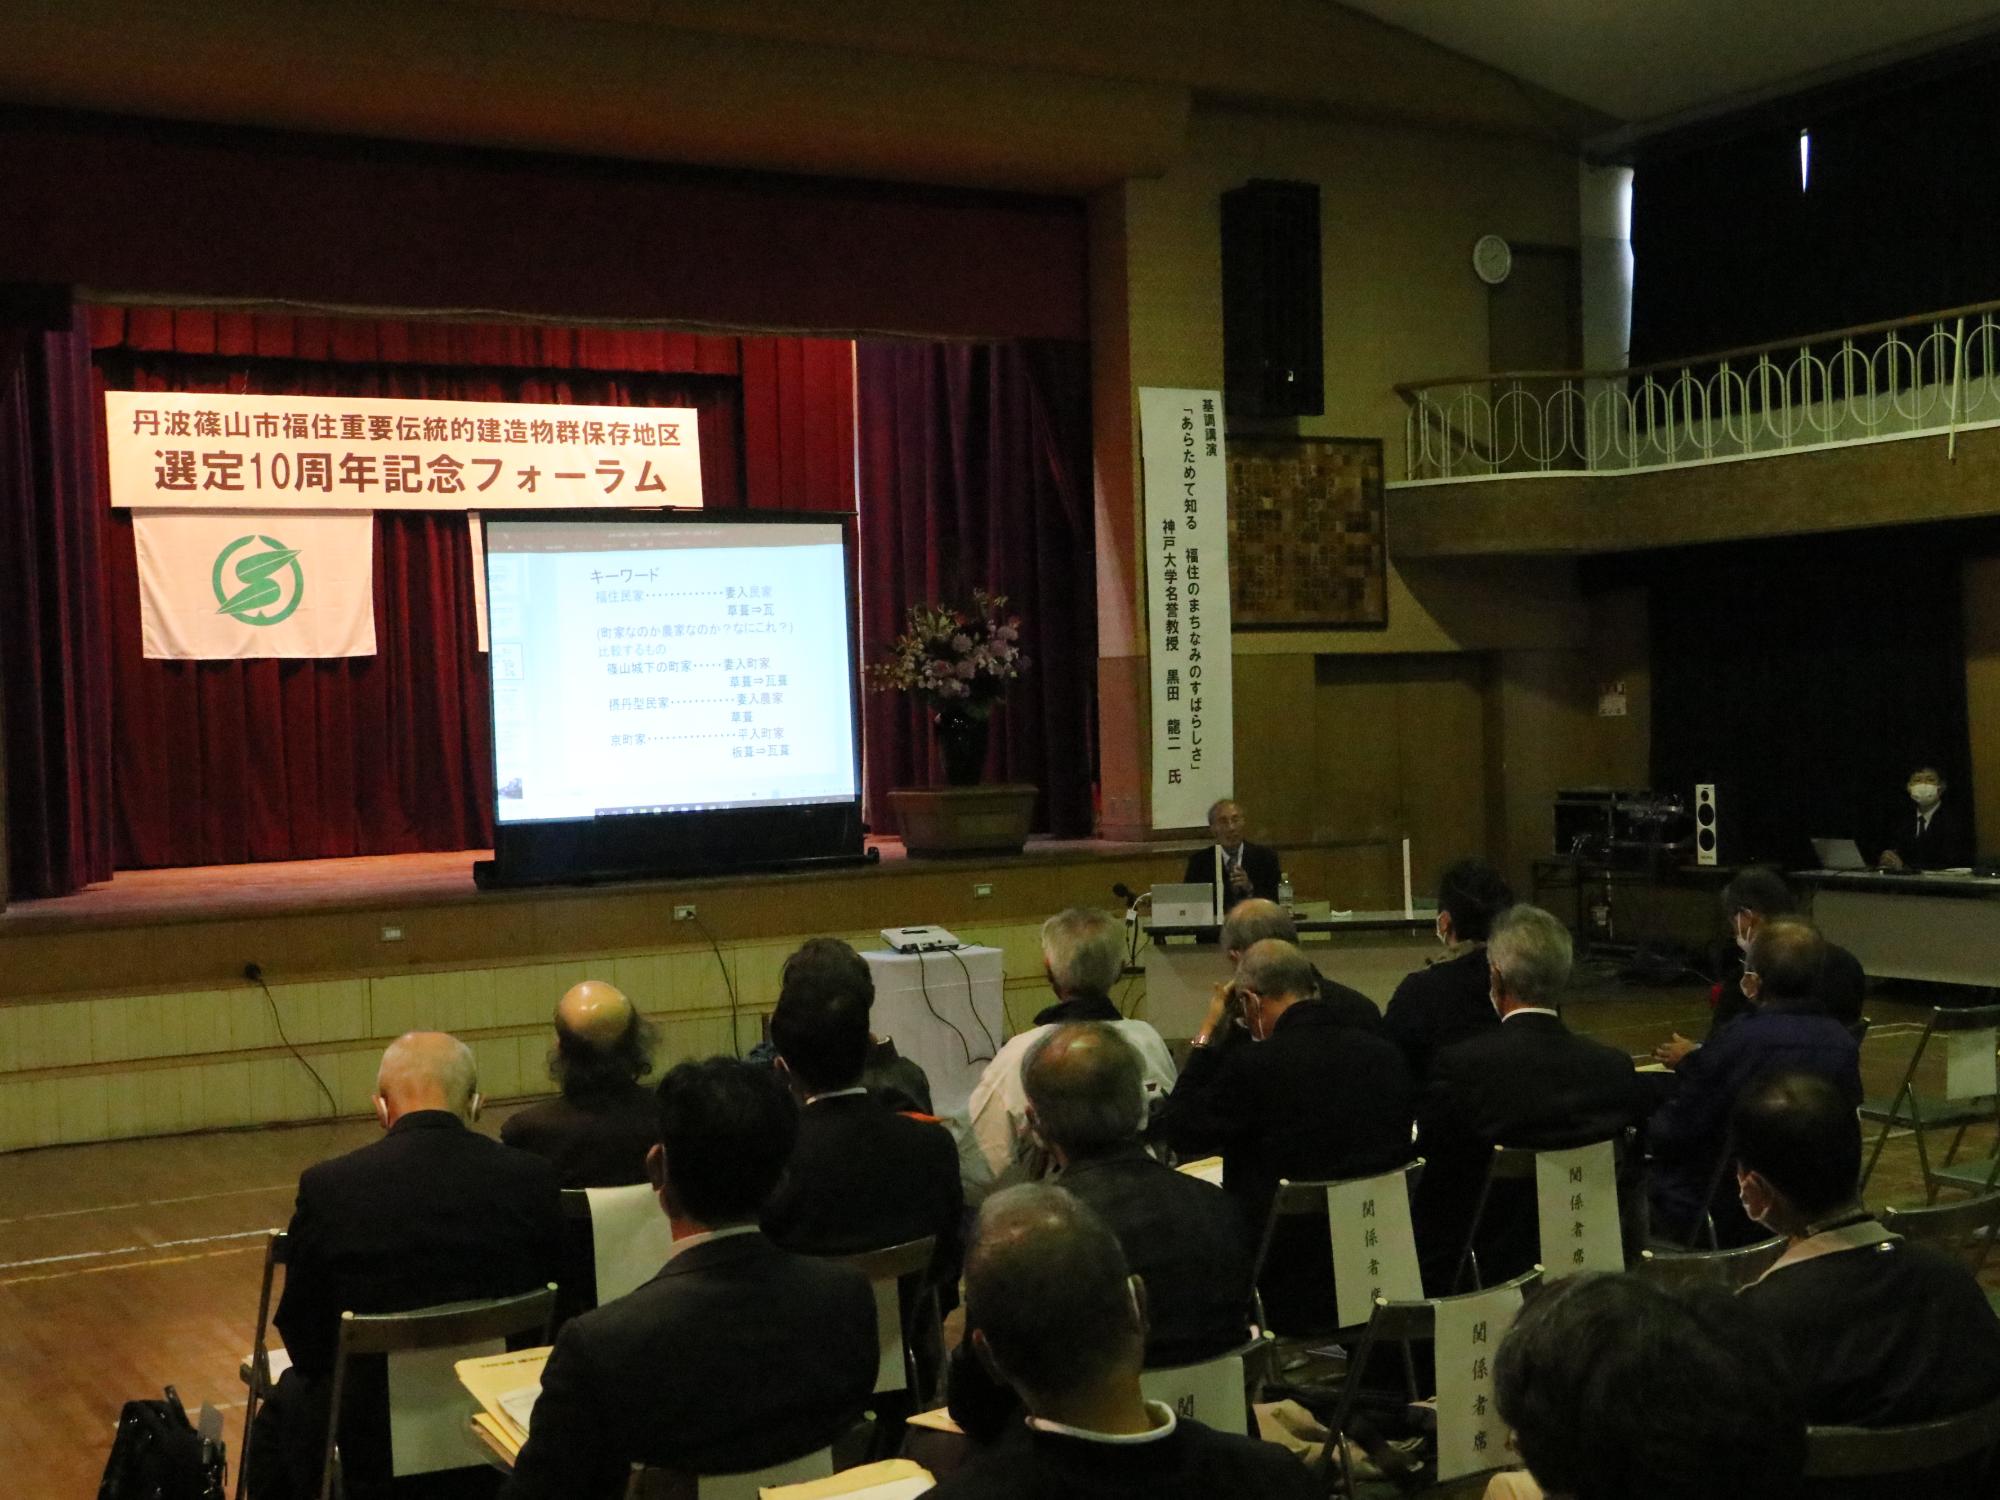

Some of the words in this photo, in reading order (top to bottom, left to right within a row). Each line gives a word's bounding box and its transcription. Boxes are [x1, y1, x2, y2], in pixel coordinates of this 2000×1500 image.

[132, 408, 682, 447] 丹波篠山市福住重要伝統的建造物群保存地区
[1201, 398, 1218, 457] 基調講演
[153, 449, 668, 495] 選定10周年記念フォーラム
[1181, 407, 1198, 531] 「あらためて知る
[590, 566, 660, 584] キーワード
[1162, 518, 1180, 652] 神戸大学名誉教授
[1166, 668, 1180, 702] 黒田
[1167, 768, 1182, 785] 氏
[1568, 1165, 1586, 1268] 関係者席
[1471, 1321, 1490, 1454] 関係者席
